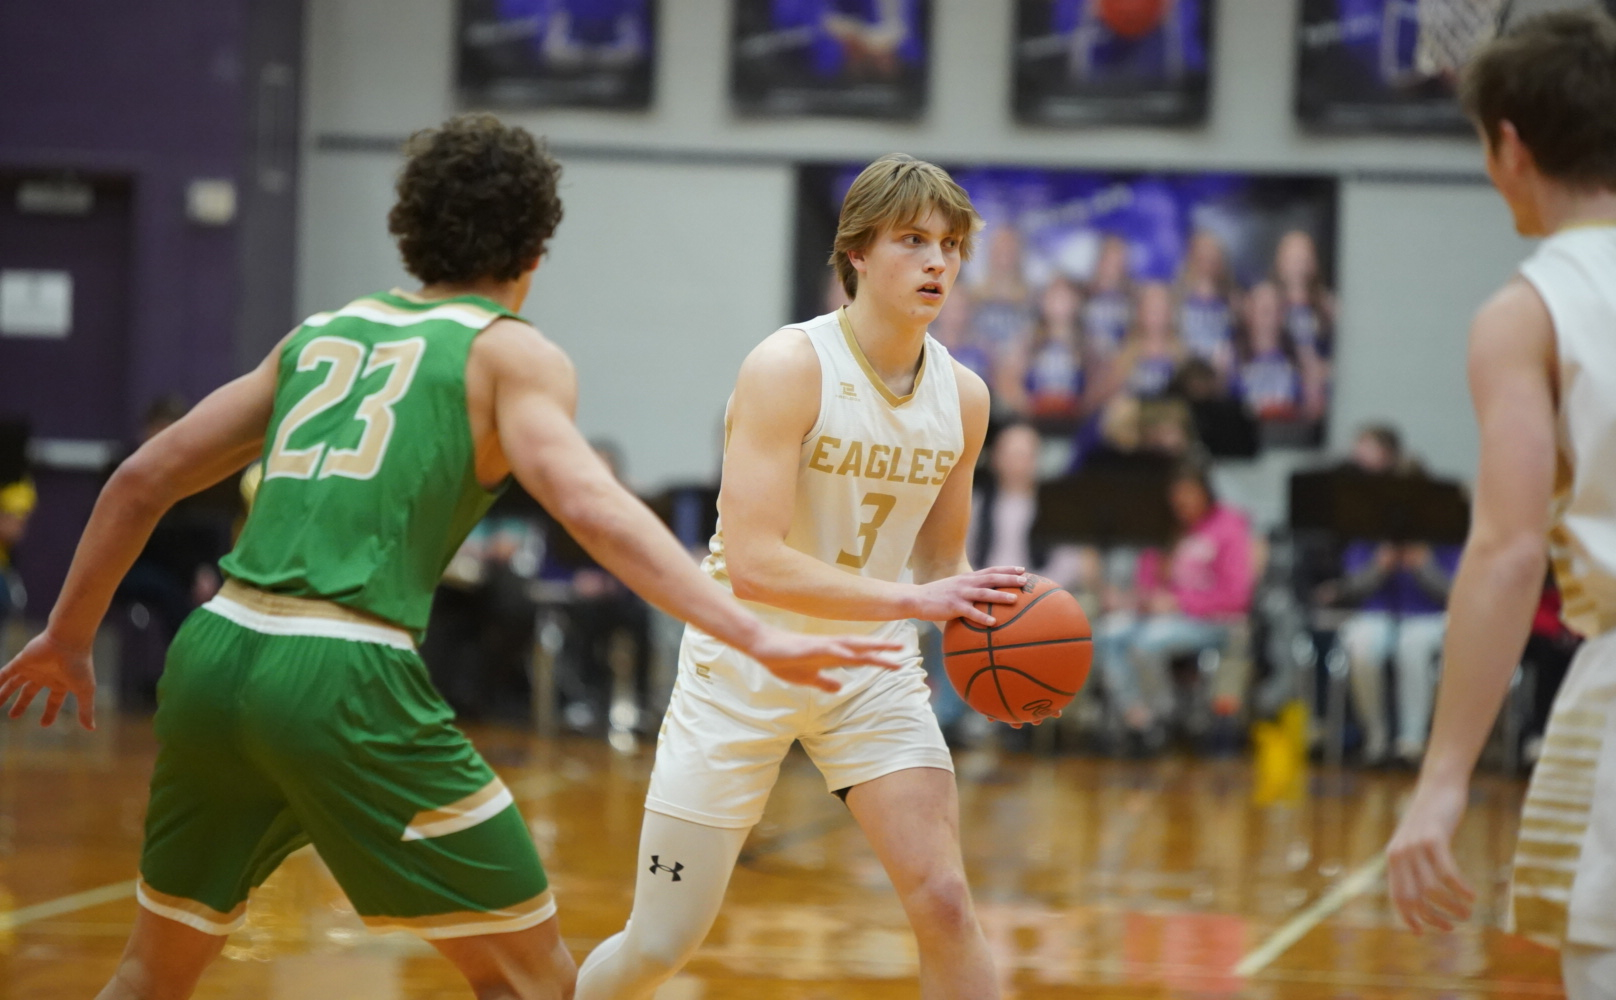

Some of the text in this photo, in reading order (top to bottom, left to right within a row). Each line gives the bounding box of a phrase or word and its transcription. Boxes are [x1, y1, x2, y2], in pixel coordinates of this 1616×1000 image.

[264, 335, 427, 481] 23
[808, 435, 955, 486] EAGLES
[835, 492, 897, 569] 3
